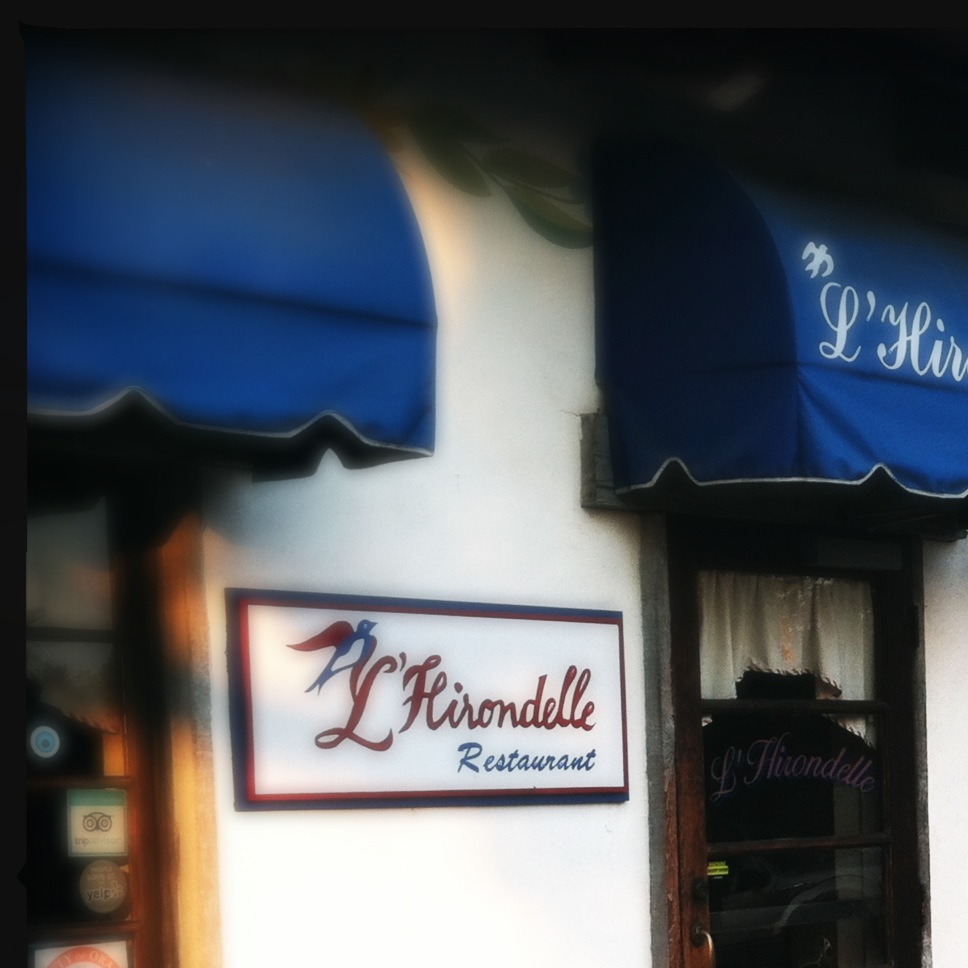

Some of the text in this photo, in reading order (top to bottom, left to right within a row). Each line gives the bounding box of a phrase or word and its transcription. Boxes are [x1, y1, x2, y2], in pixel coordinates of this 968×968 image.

[314, 651, 596, 752] L'Hirondelle
[457, 741, 597, 774] Restaurant
[86, 887, 111, 901] yelp
